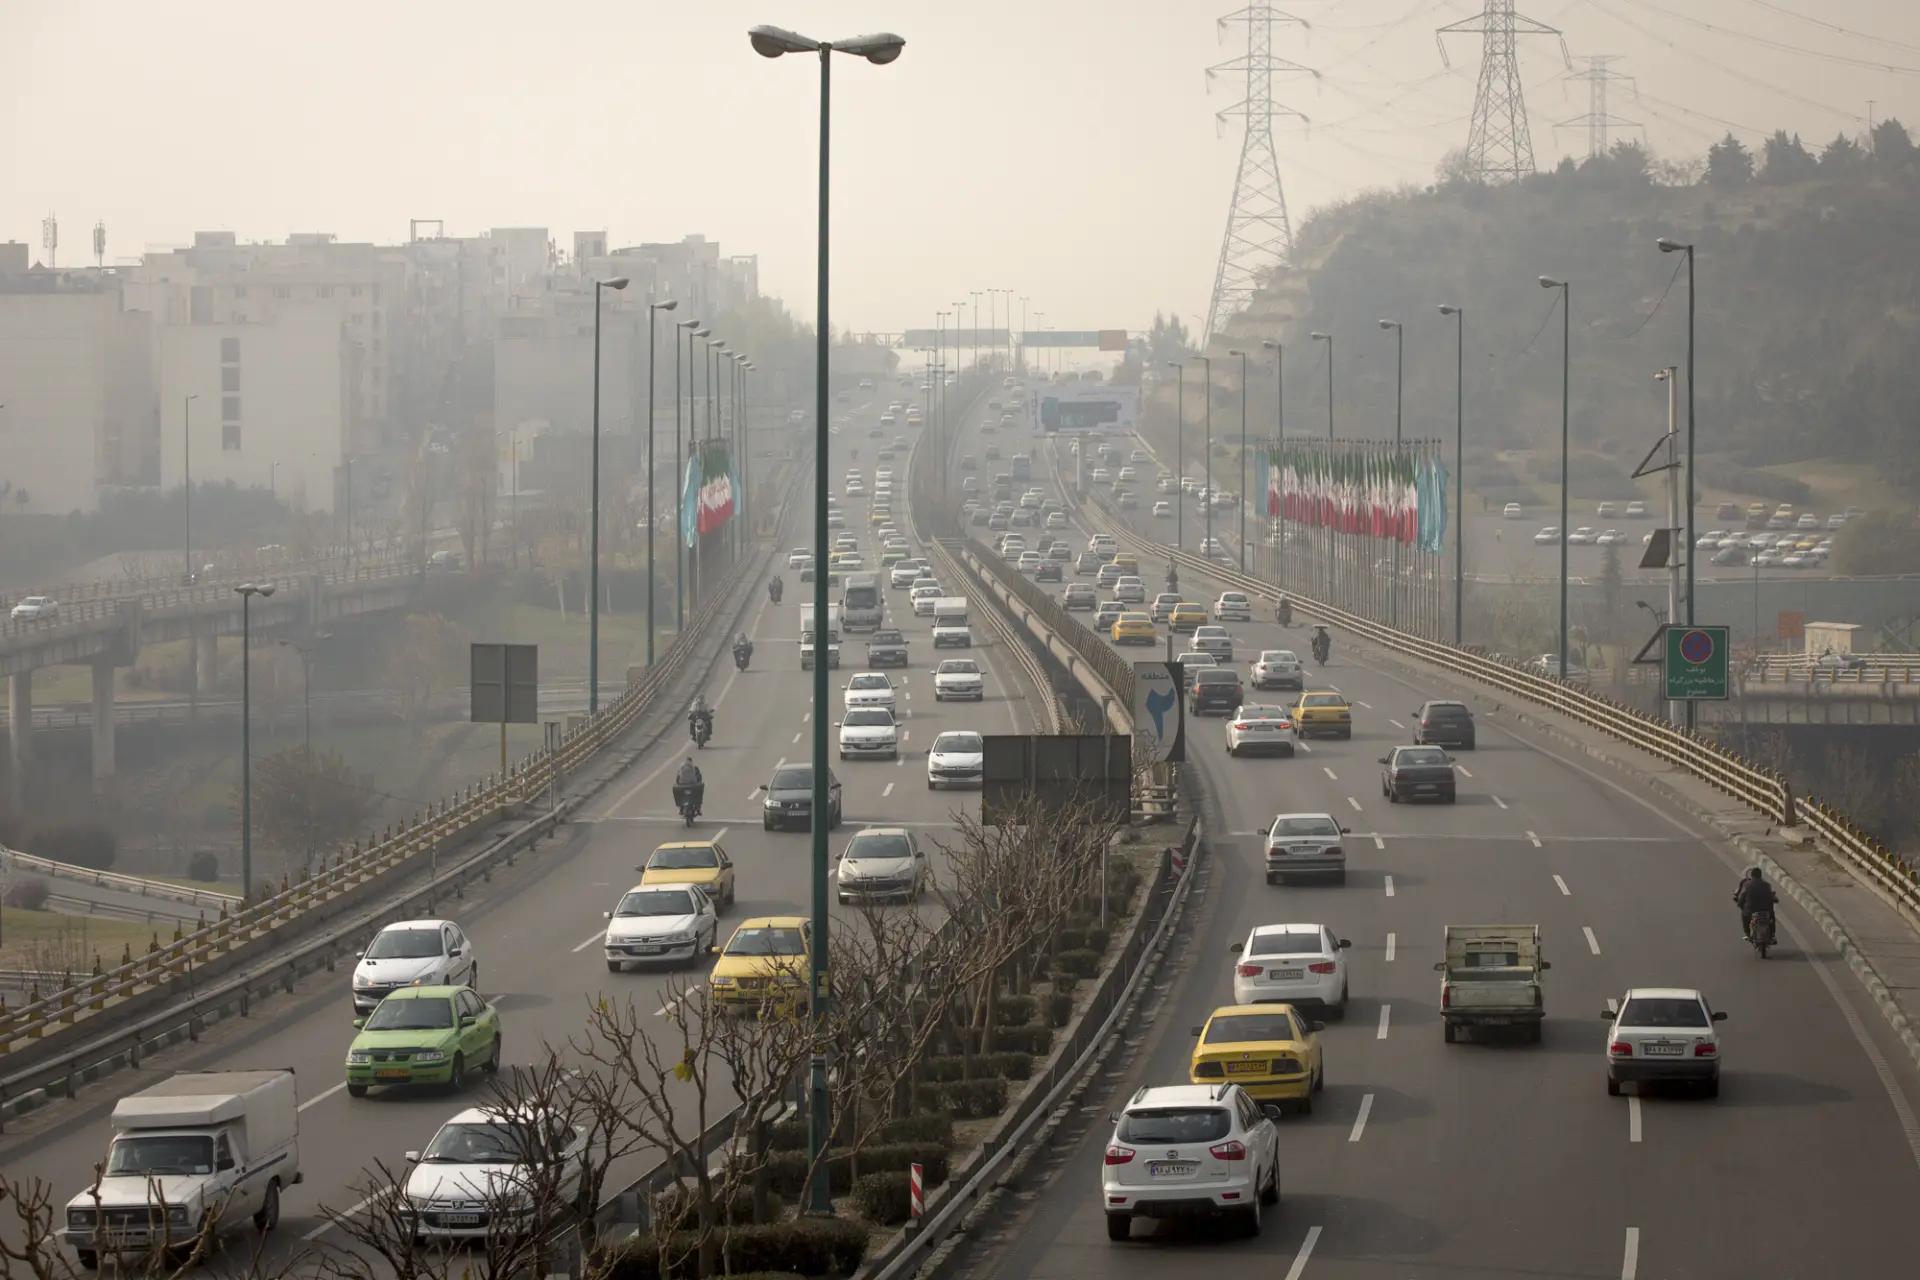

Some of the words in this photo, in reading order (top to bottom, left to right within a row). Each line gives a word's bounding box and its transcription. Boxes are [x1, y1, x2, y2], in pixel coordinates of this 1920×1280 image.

[1141, 671, 1169, 680] منطقه
[1669, 676, 1694, 686] بزرگراه
[1686, 688, 1708, 699] ممنوع
